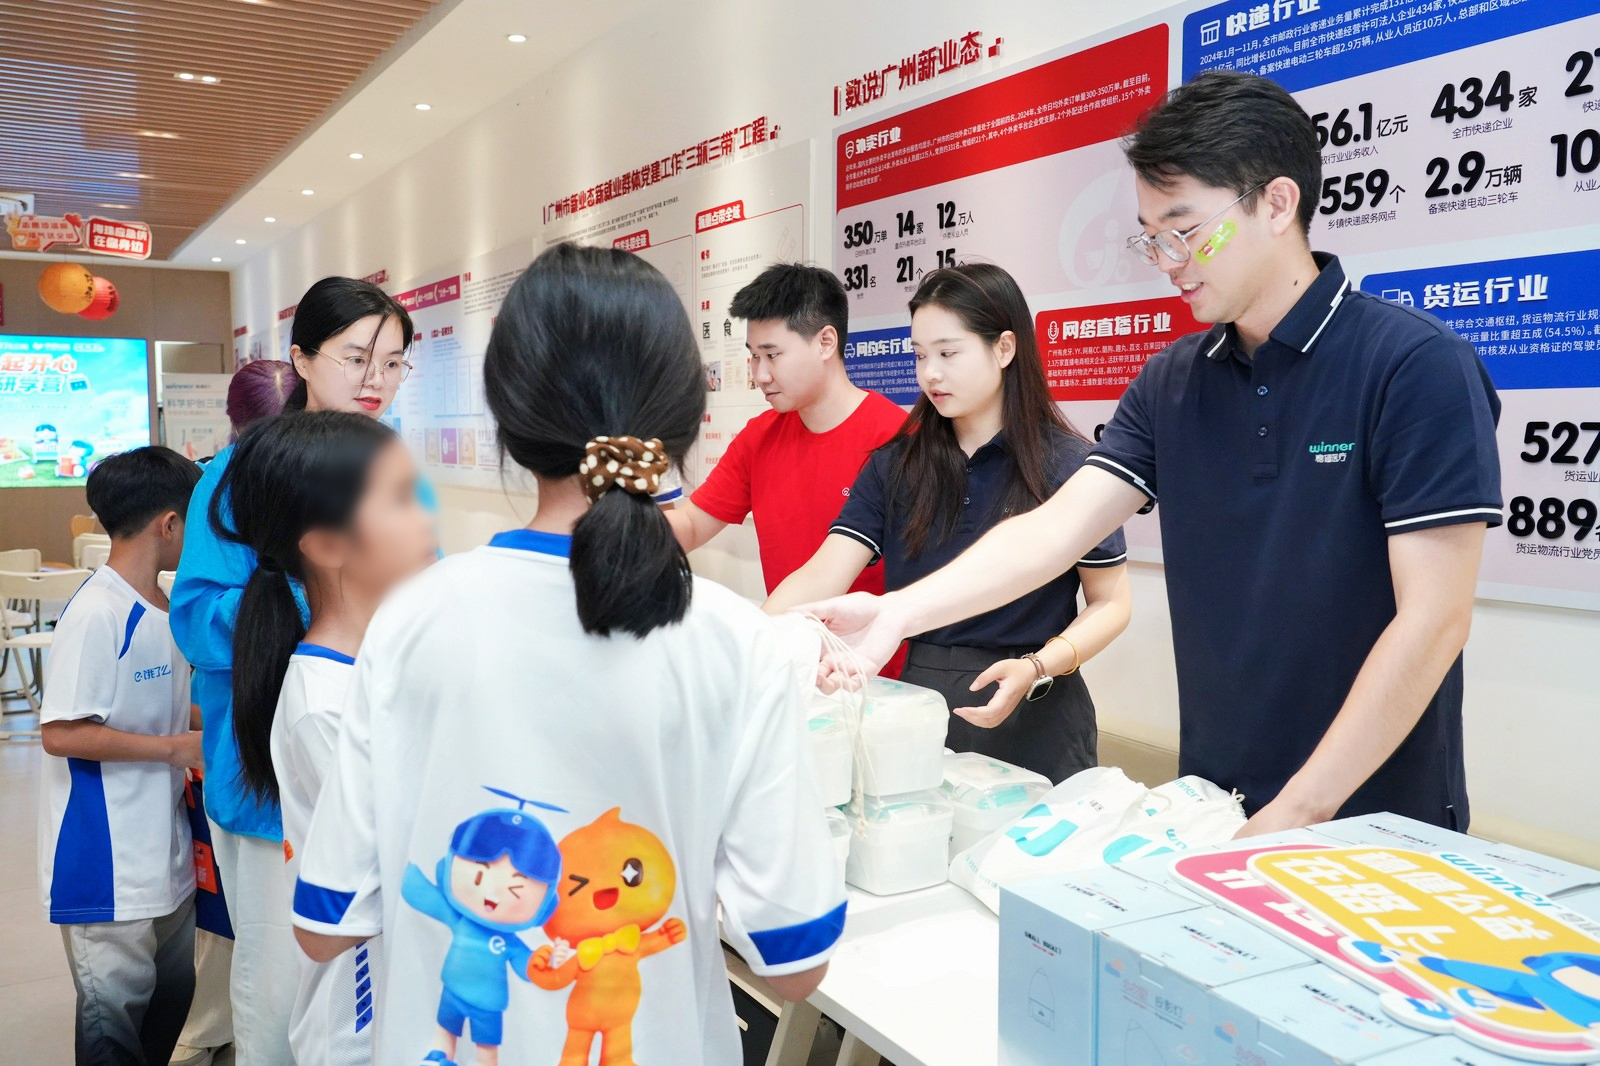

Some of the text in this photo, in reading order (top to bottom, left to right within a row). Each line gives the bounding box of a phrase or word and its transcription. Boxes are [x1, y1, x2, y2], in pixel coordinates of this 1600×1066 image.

[845, 30, 983, 111] 数说广州新业态
[1430, 70, 1538, 124] 434 家
[855, 126, 901, 154] 外卖行业
[1376, 114, 1409, 138] 亿元
[1452, 117, 1513, 140] 全市快递企业
[1320, 145, 1379, 166] 政行业业务收入
[1425, 150, 1523, 201] 2.9 万辆
[1319, 168, 1406, 215] 559 个
[1427, 191, 1518, 216] 备案快递电动三轮车
[896, 210, 924, 238] 14 家
[936, 201, 974, 230] 12 万人
[1327, 210, 1397, 230] 乡镇快递服务网点
[843, 220, 888, 249] 350 万单
[896, 255, 924, 283] 21 个
[936, 248, 956, 269] 15
[843, 264, 877, 291] 331 名
[1422, 273, 1549, 310] 货运行业
[1062, 312, 1172, 340] 网络直播行业
[1441, 309, 1600, 331] 性综合交通枢纽,货运物流行业规
[1309, 441, 1356, 453] winner
[1520, 421, 1600, 465] 527
[1564, 469, 1600, 483] 货运业
[1507, 496, 1598, 541] 889
[1440, 852, 1562, 910] winner
[1270, 856, 1457, 947] 在路上
